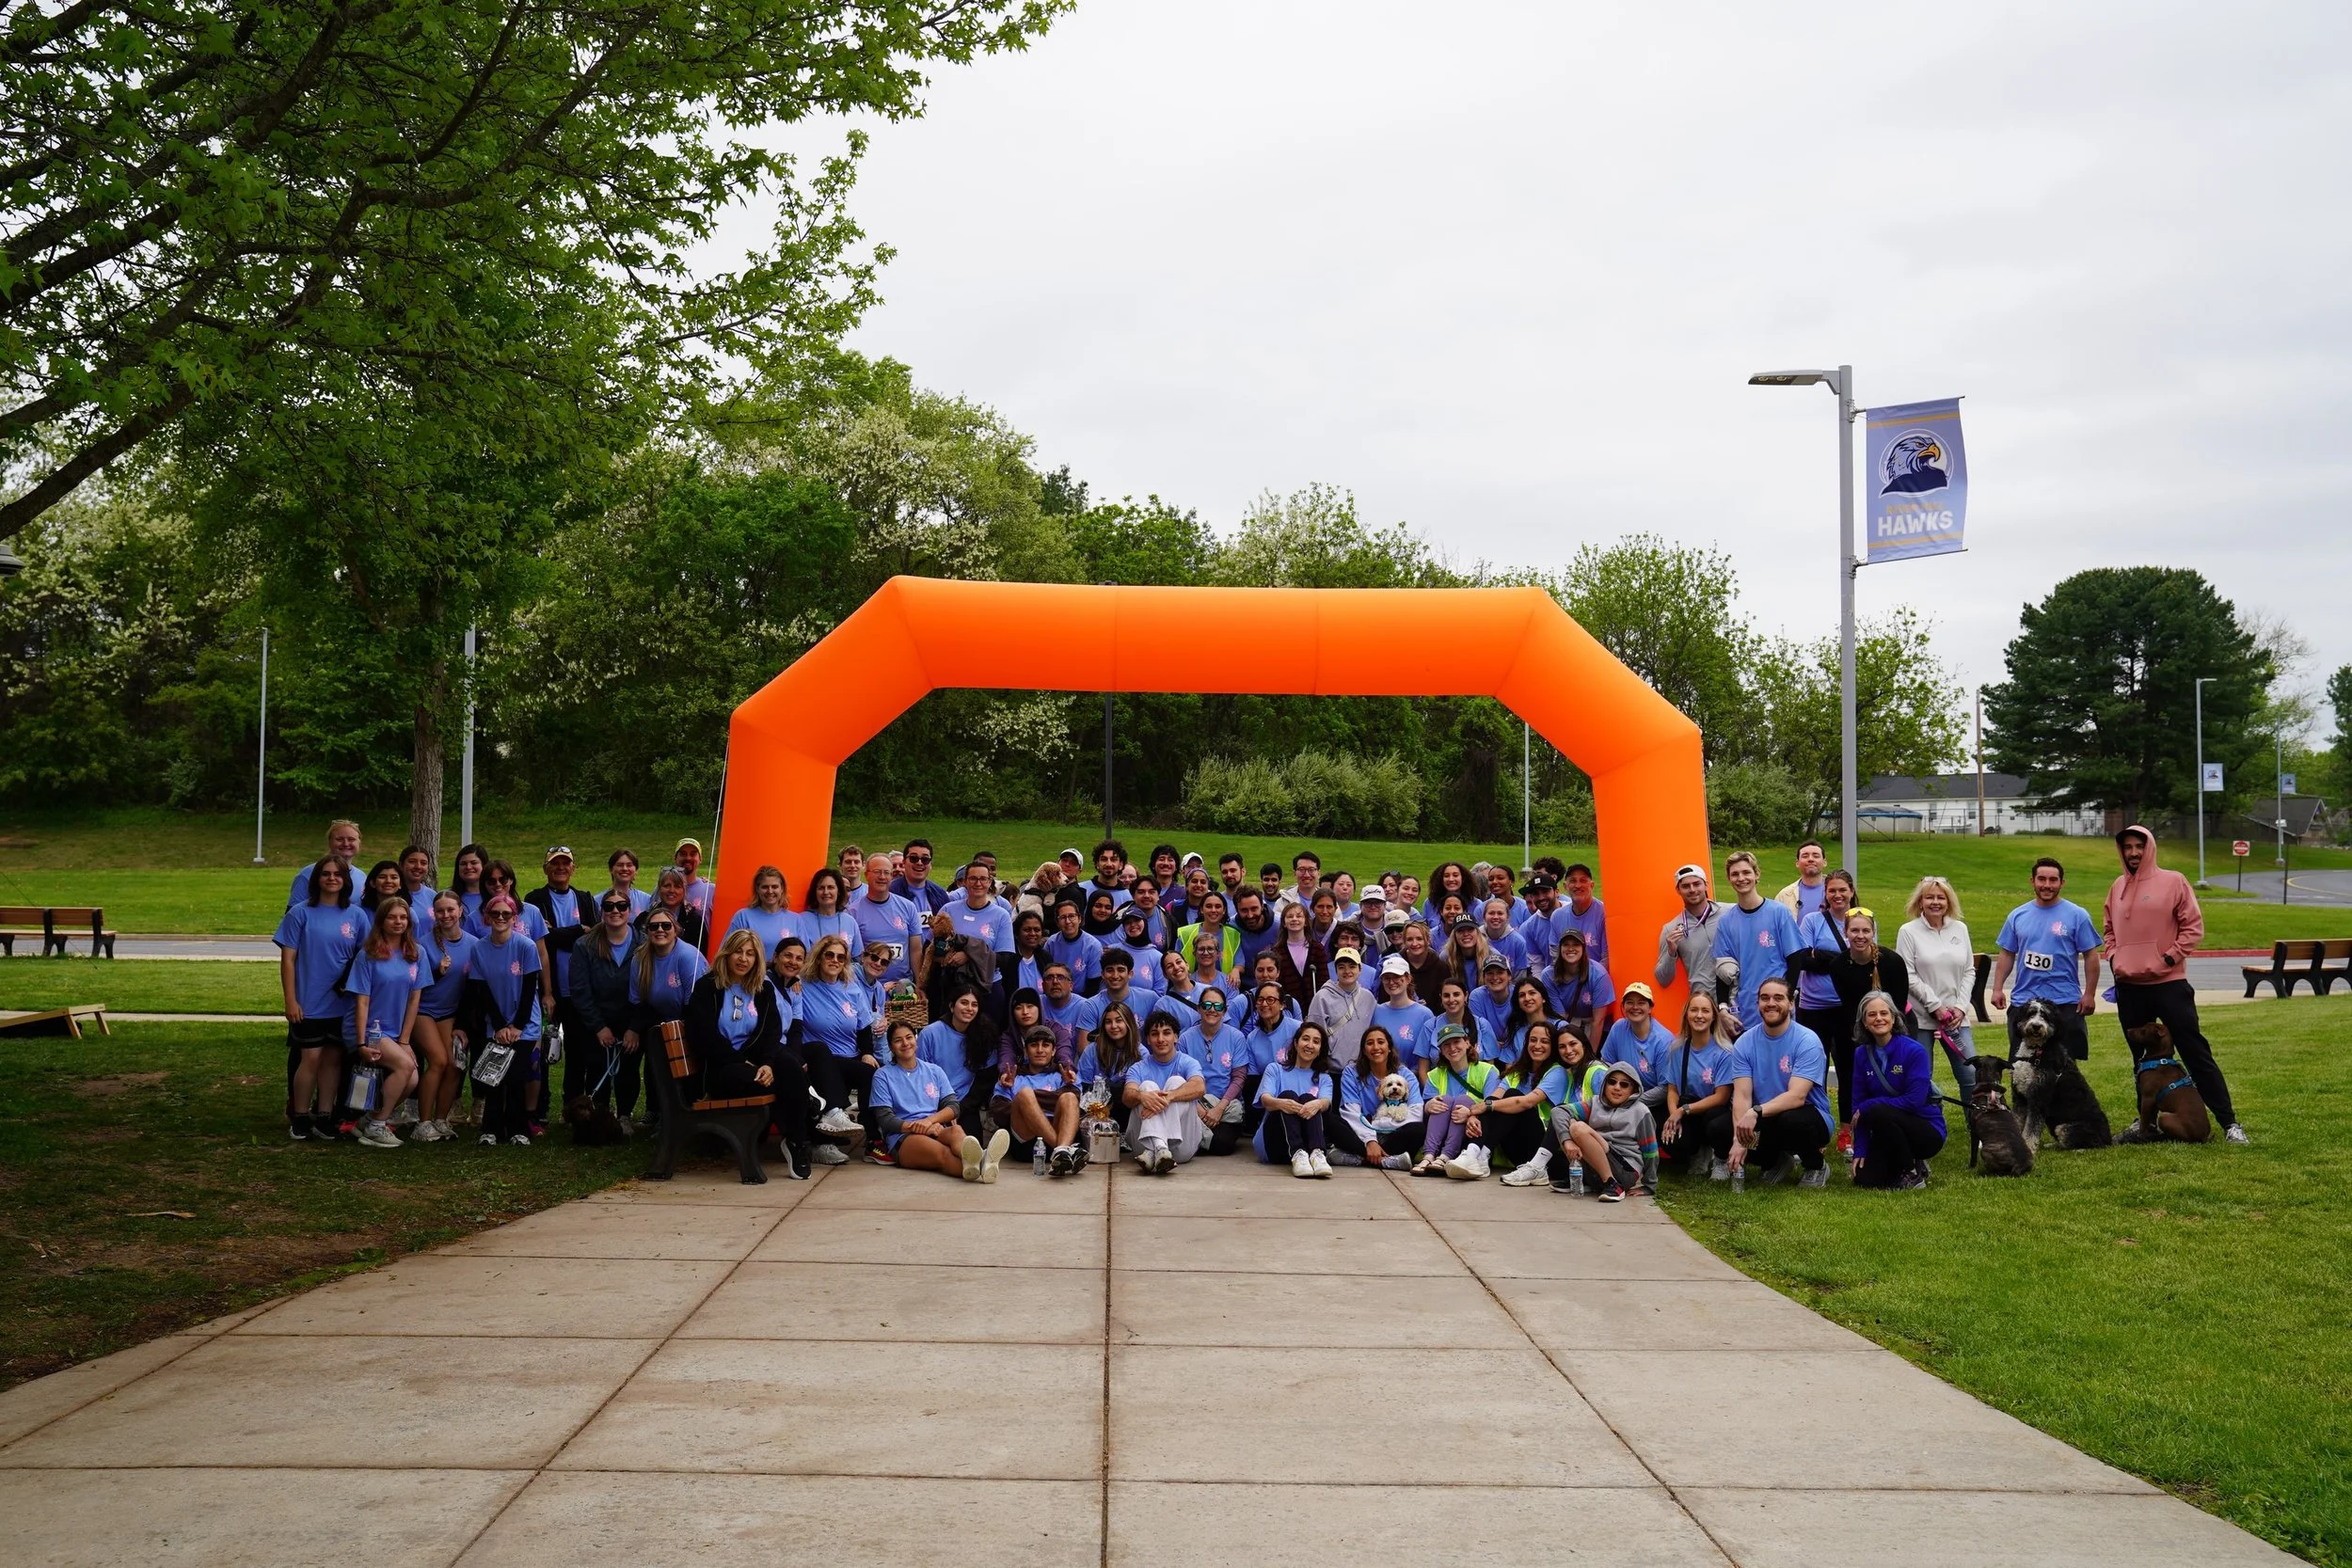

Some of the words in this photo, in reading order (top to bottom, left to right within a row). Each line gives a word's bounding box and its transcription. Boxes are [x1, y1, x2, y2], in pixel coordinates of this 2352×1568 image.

[1877, 510, 1953, 537] HAWKS
[1456, 914, 1472, 923] BAL
[2026, 954, 2051, 969] 130
